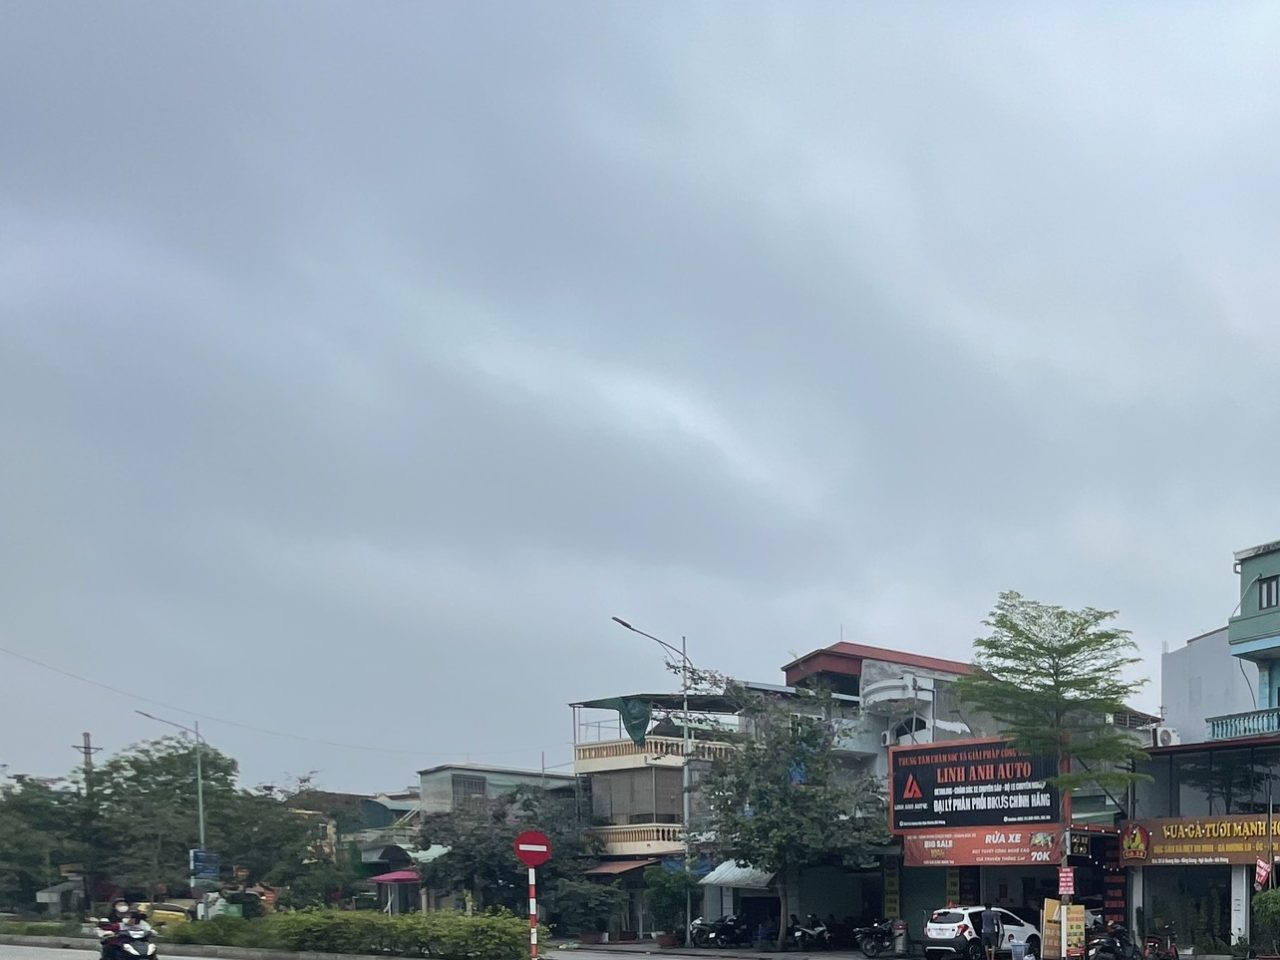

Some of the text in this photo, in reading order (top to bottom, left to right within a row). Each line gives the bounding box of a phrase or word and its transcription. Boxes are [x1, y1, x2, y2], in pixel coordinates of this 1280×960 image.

[936, 761, 1032, 784] LINH ANH AUTO
[985, 830, 1006, 844] RỬA
[1008, 833, 1022, 843] XE
[1162, 824, 1186, 838] VUA
[1232, 821, 1267, 840] MẠNH
[924, 839, 953, 848] BIG SALE
[1030, 851, 1051, 861] 70K
